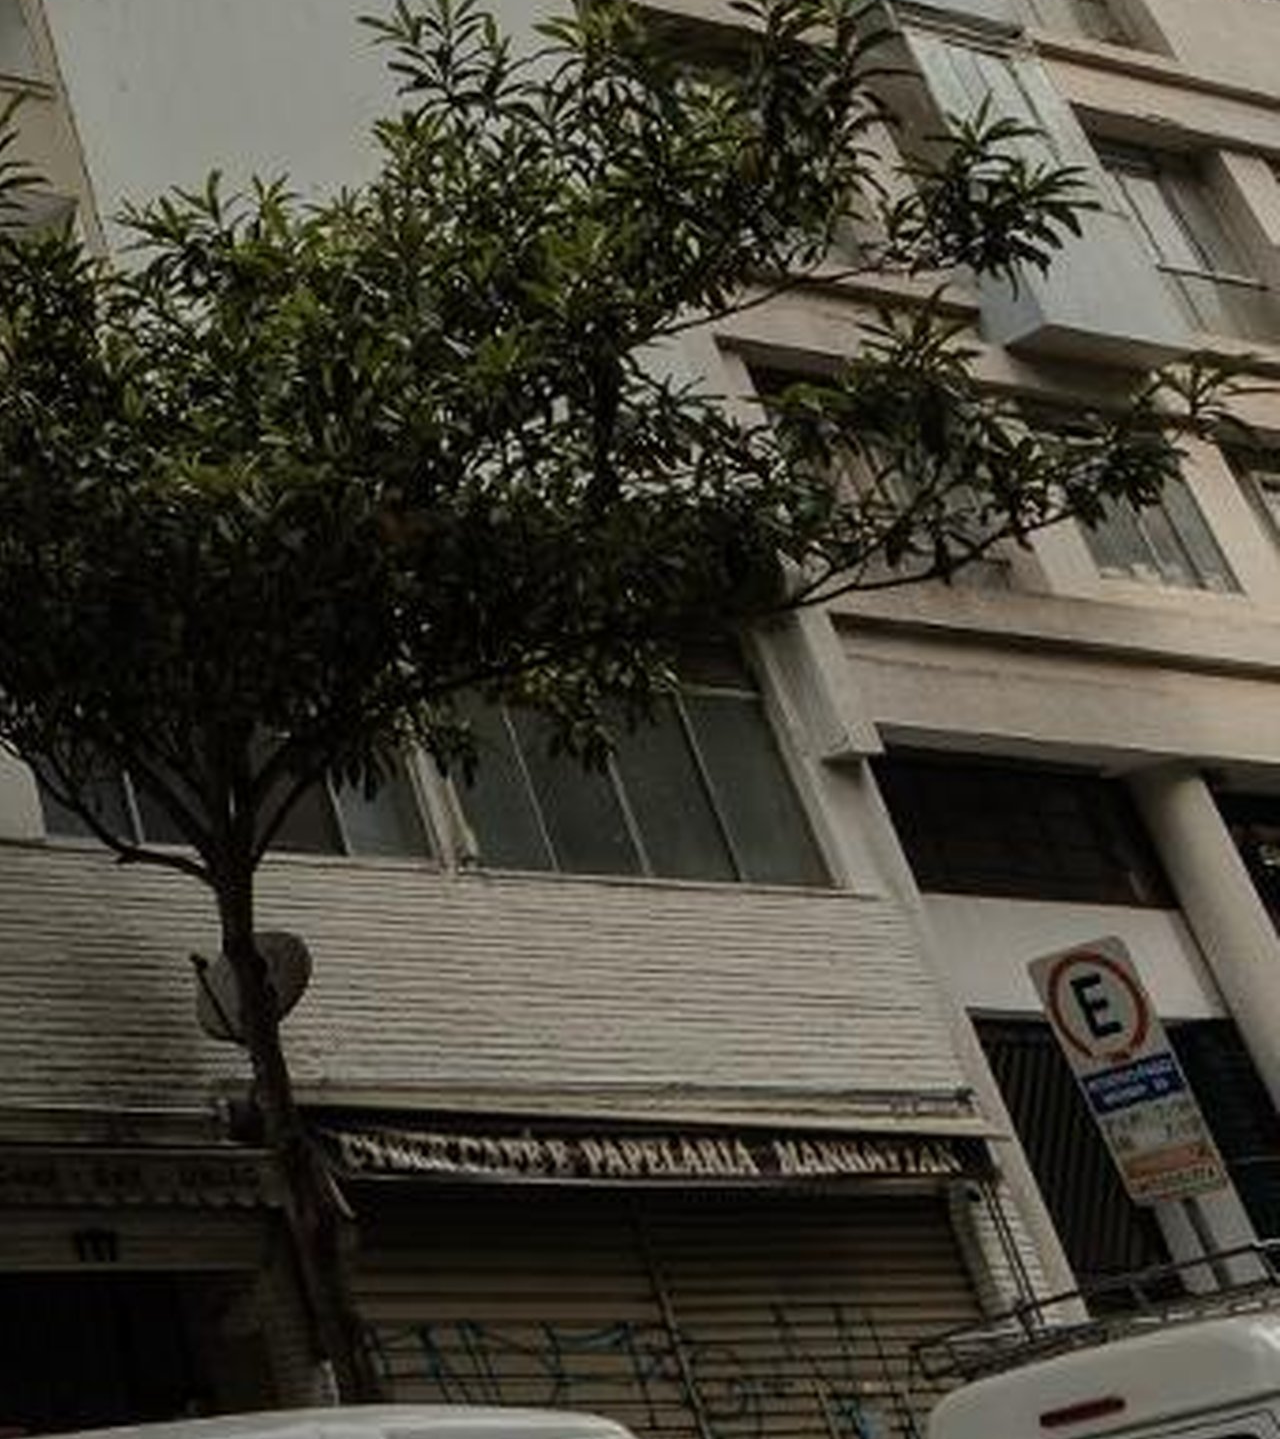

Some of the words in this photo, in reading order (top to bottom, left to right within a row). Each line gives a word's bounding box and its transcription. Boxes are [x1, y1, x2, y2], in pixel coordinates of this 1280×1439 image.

[1070, 972, 1124, 1040] E
[578, 1136, 762, 1178] PAPELARIA
[773, 1137, 964, 1177] MANHATTAN
